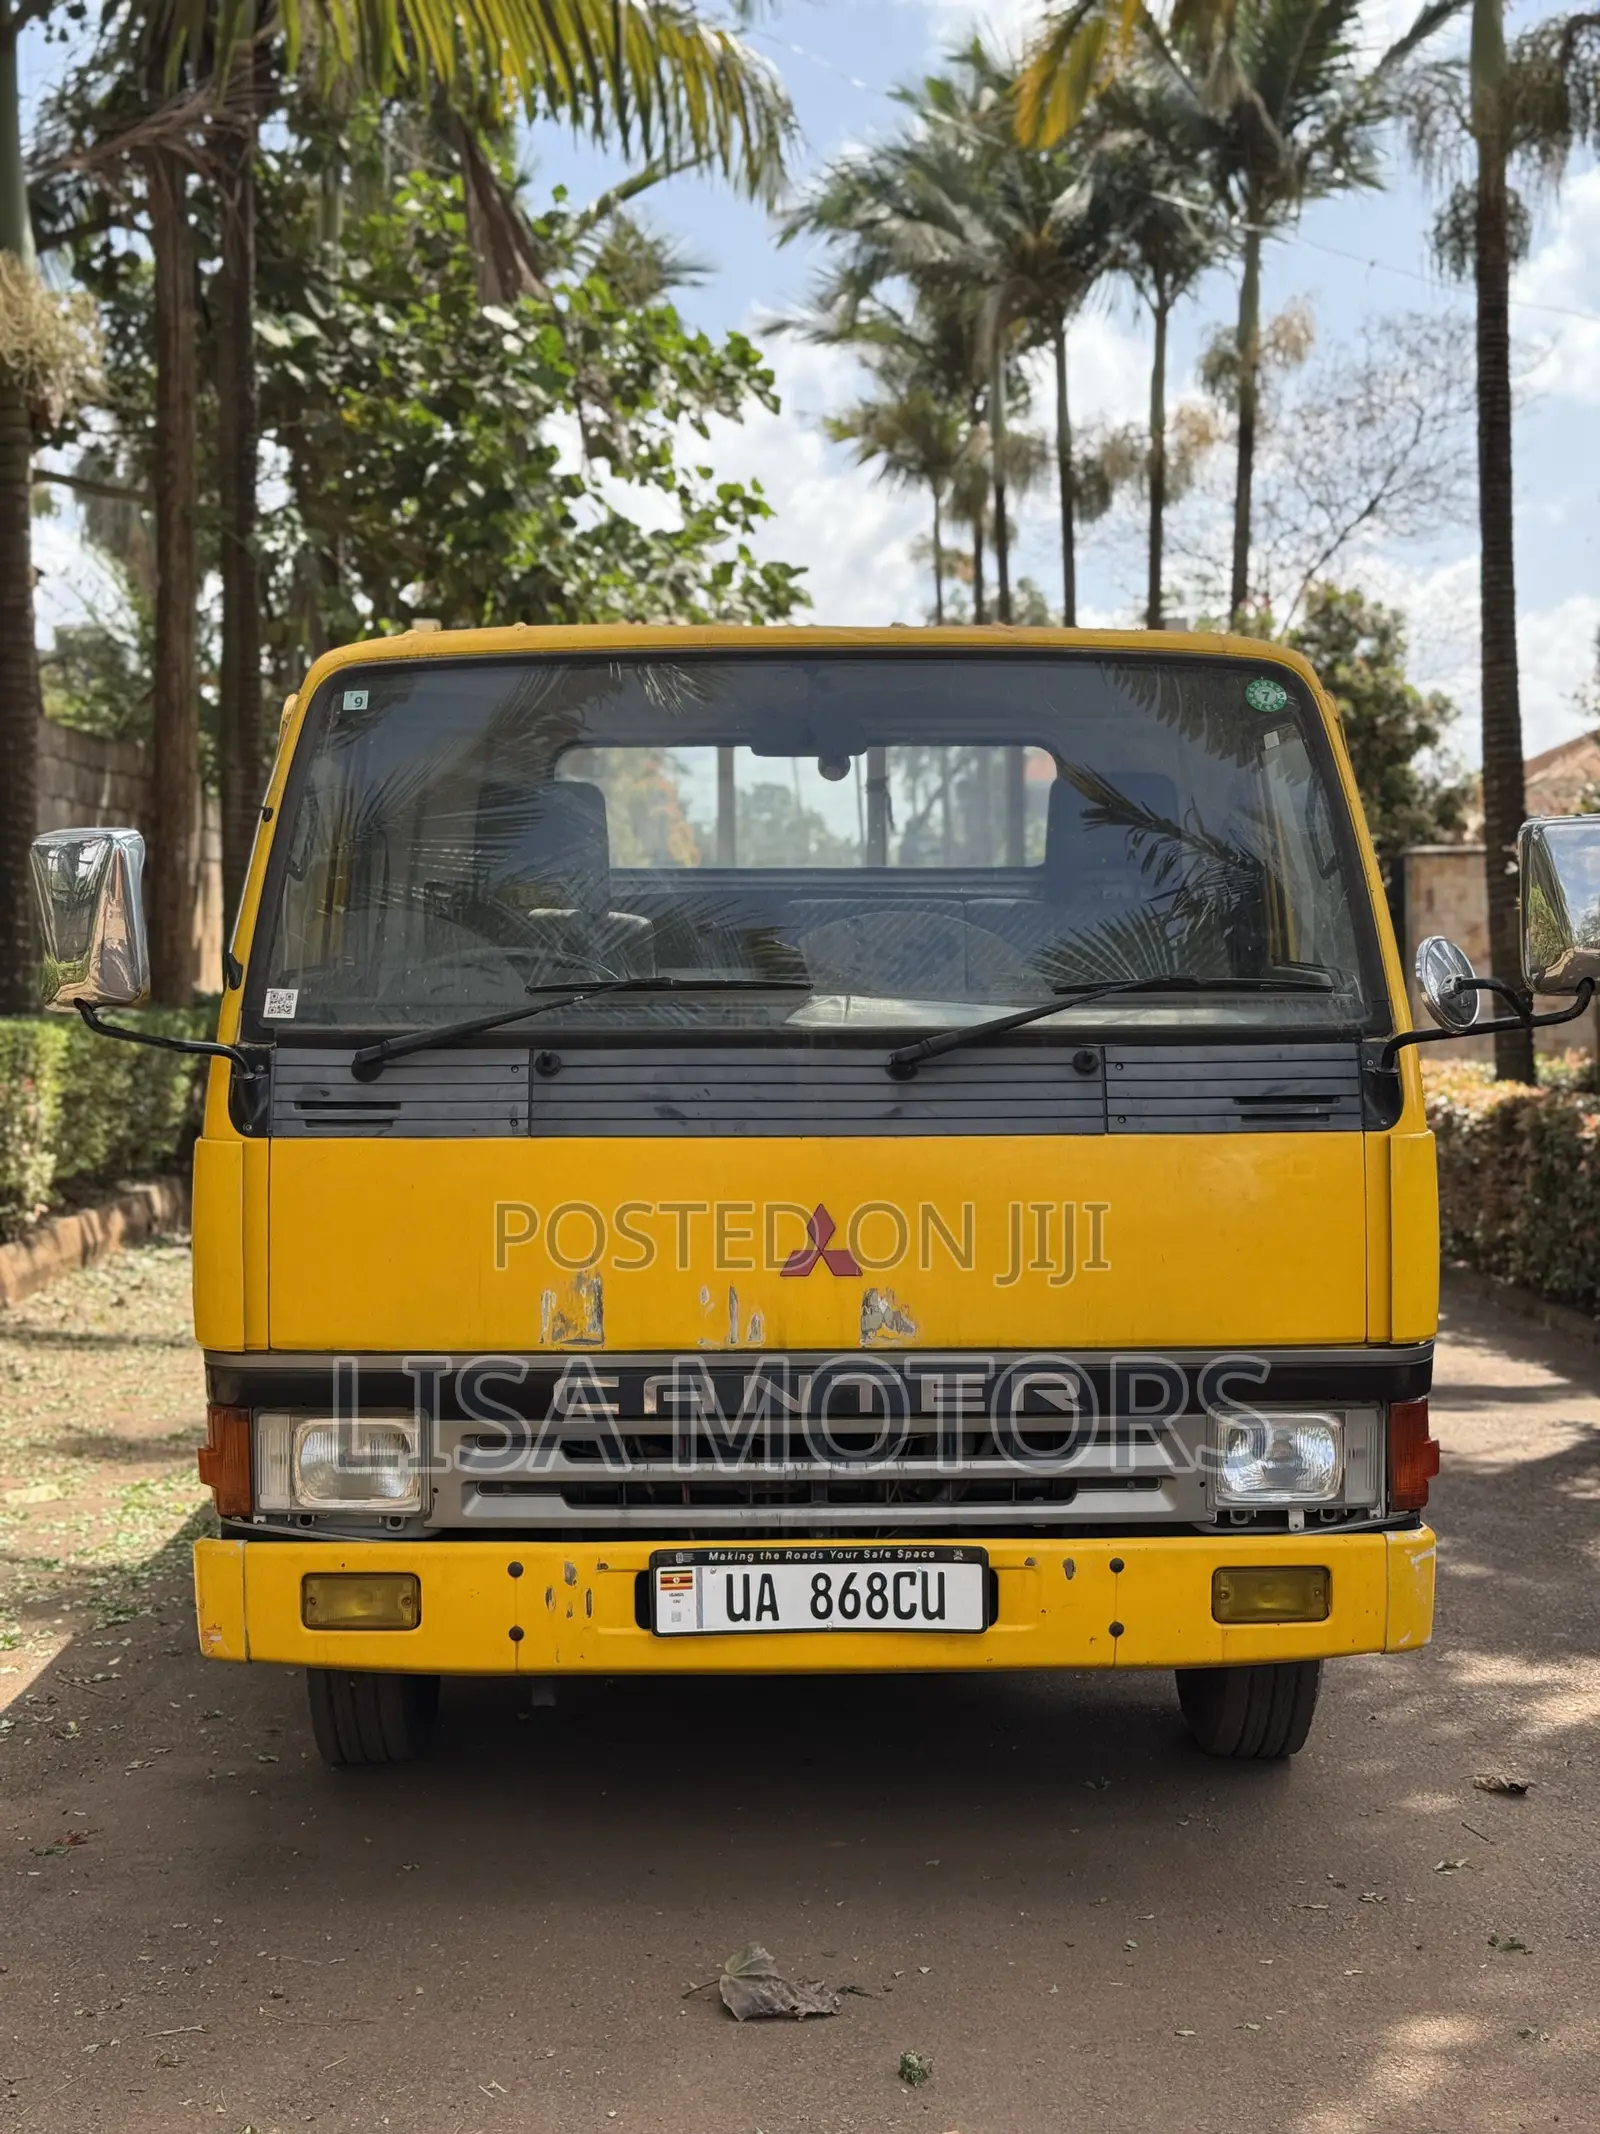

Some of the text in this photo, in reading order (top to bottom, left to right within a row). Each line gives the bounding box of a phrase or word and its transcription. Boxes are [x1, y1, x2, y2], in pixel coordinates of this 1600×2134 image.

[355, 696, 363, 707] 9
[1262, 691, 1269, 702] 7
[553, 1373, 1085, 1415] CANTER
[708, 1548, 936, 1562] Making the Roads Your Safe Space
[725, 1571, 946, 1622] UA 868CU
